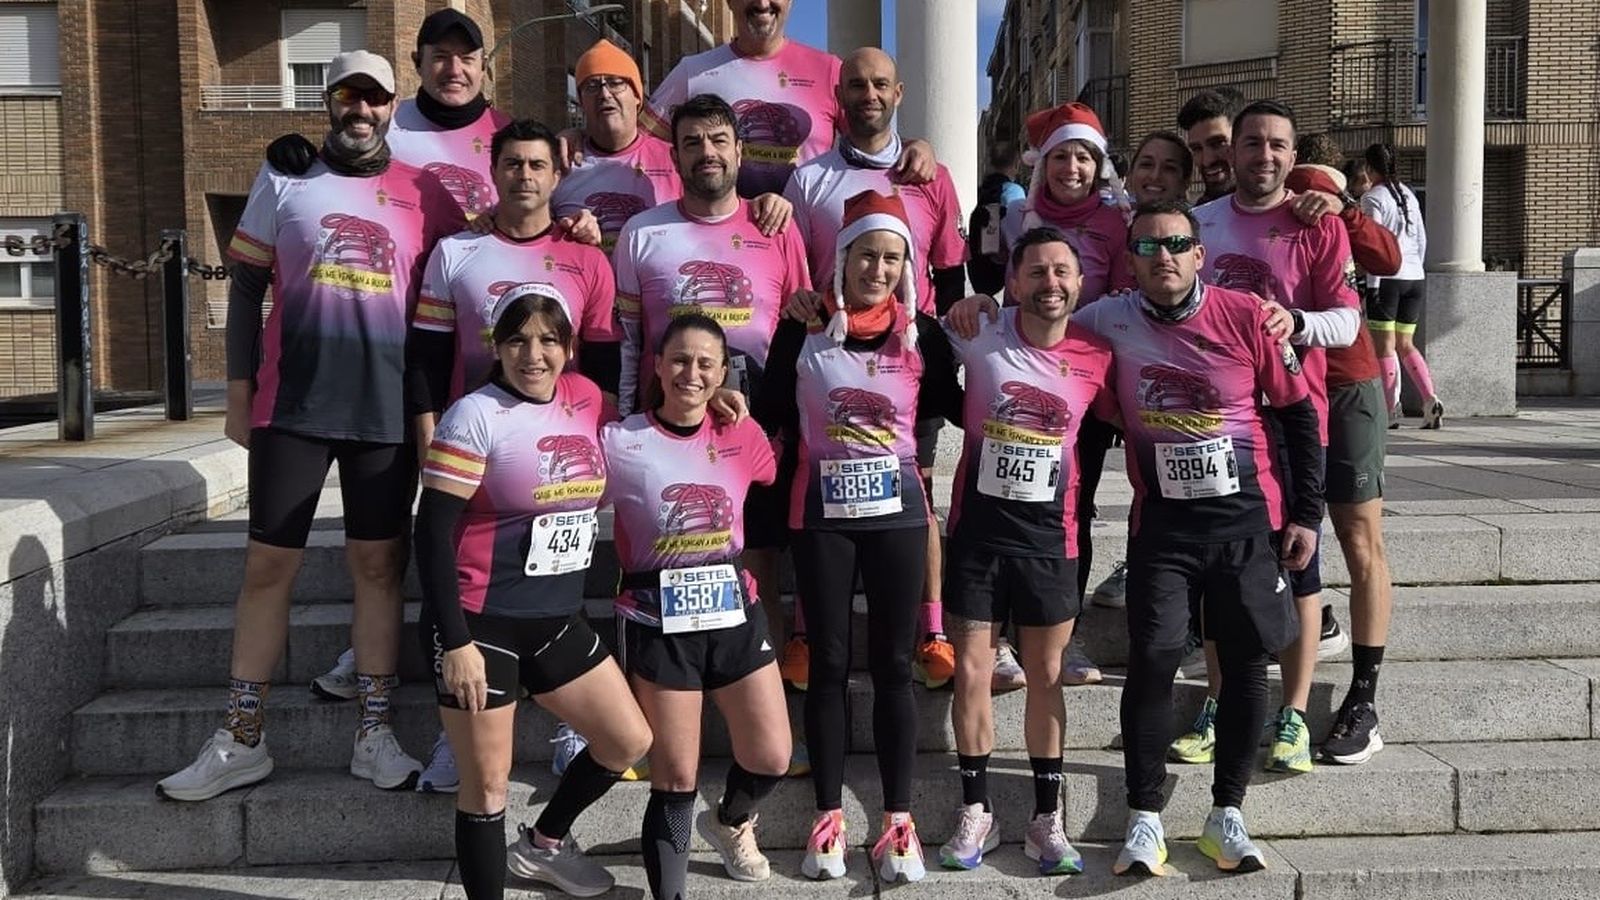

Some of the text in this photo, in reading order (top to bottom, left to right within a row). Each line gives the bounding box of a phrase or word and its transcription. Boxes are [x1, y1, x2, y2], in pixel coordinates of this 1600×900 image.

[996, 427, 1008, 435] ME
[1003, 445, 1054, 458] SETEL
[1173, 441, 1225, 456] SETEL
[841, 459, 893, 473] SETEL
[996, 456, 1036, 482] 845
[1166, 456, 1219, 481] 3894
[534, 489, 551, 500] QUE
[554, 487, 564, 496] ME
[831, 473, 884, 500] 3893
[555, 513, 593, 526] SETEL
[547, 528, 580, 553] 434
[684, 569, 732, 582] SETEL
[673, 583, 724, 612] 3587
